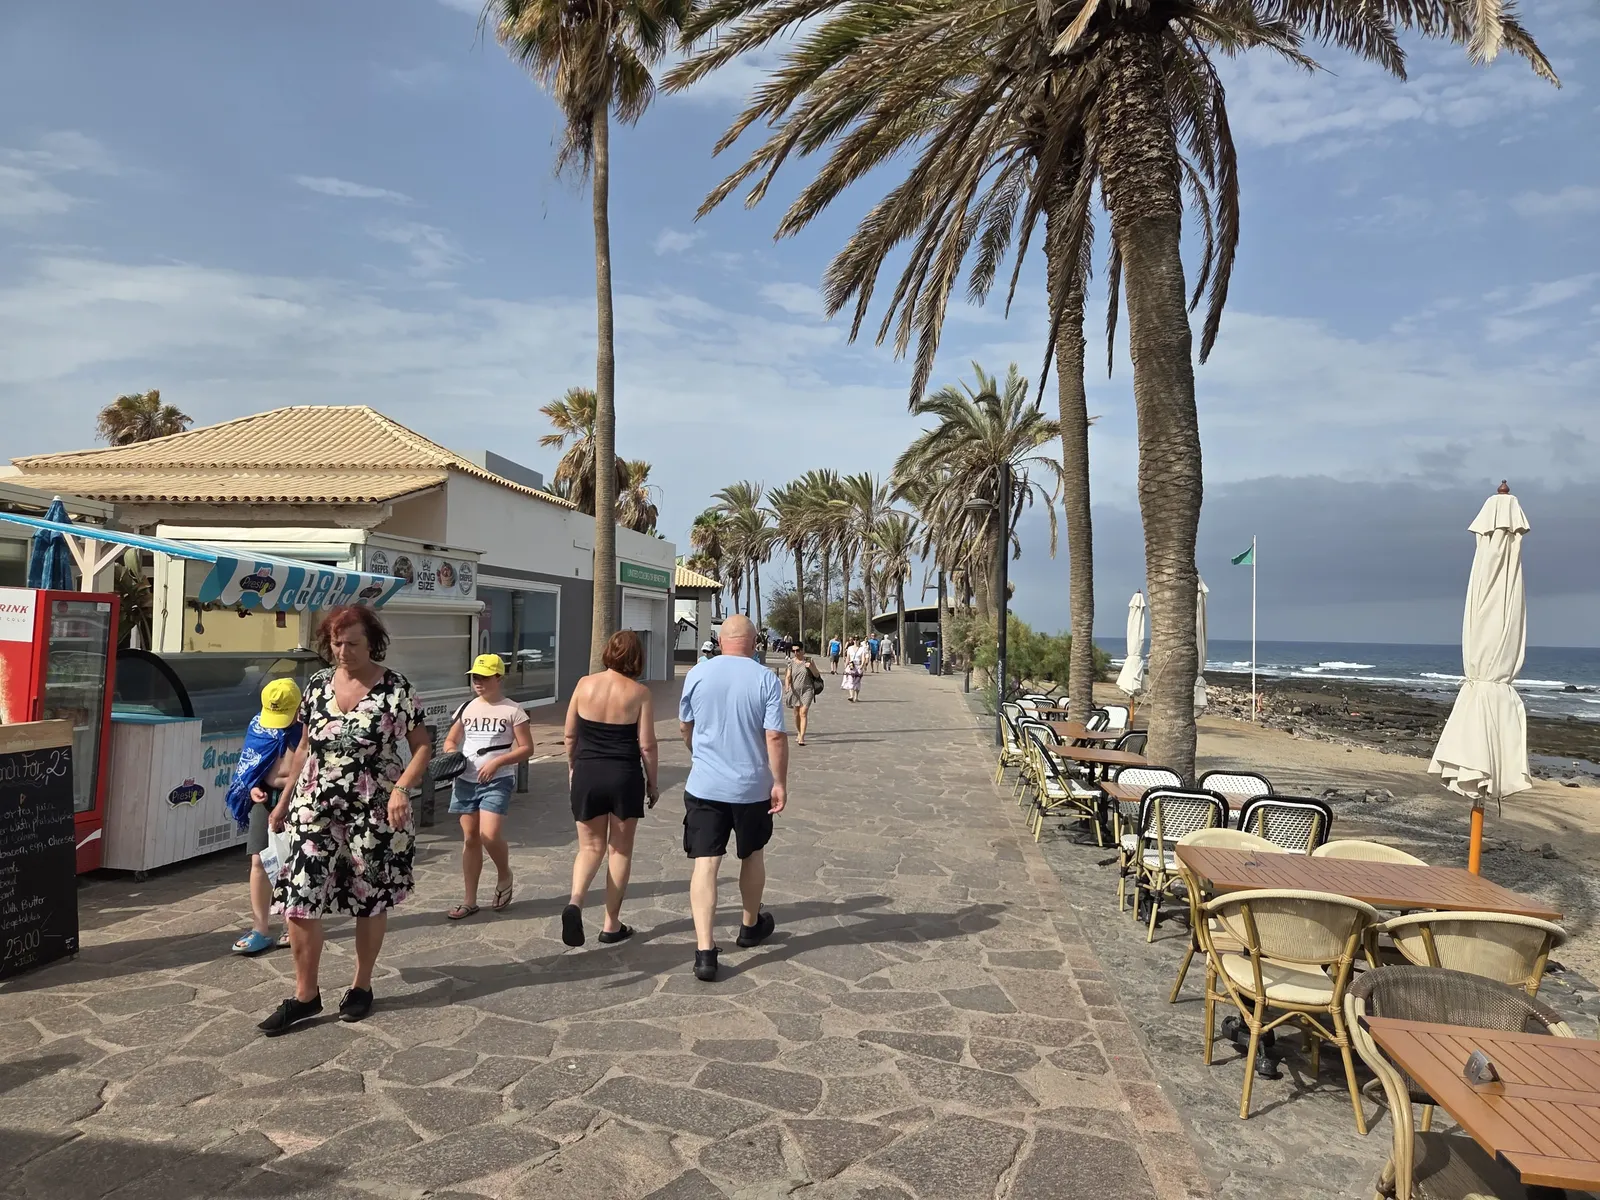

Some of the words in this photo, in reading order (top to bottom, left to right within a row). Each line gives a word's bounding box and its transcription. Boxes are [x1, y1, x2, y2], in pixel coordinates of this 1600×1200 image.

[371, 563, 389, 574] CREPES
[305, 573, 345, 591] ICE
[417, 571, 436, 582] KING
[417, 581, 435, 591] SIZE
[282, 589, 352, 606] CREAM
[0, 603, 29, 614] RINK
[426, 704, 447, 716] CREPES
[464, 717, 508, 733] PARIS
[46, 750, 67, 776] 2
